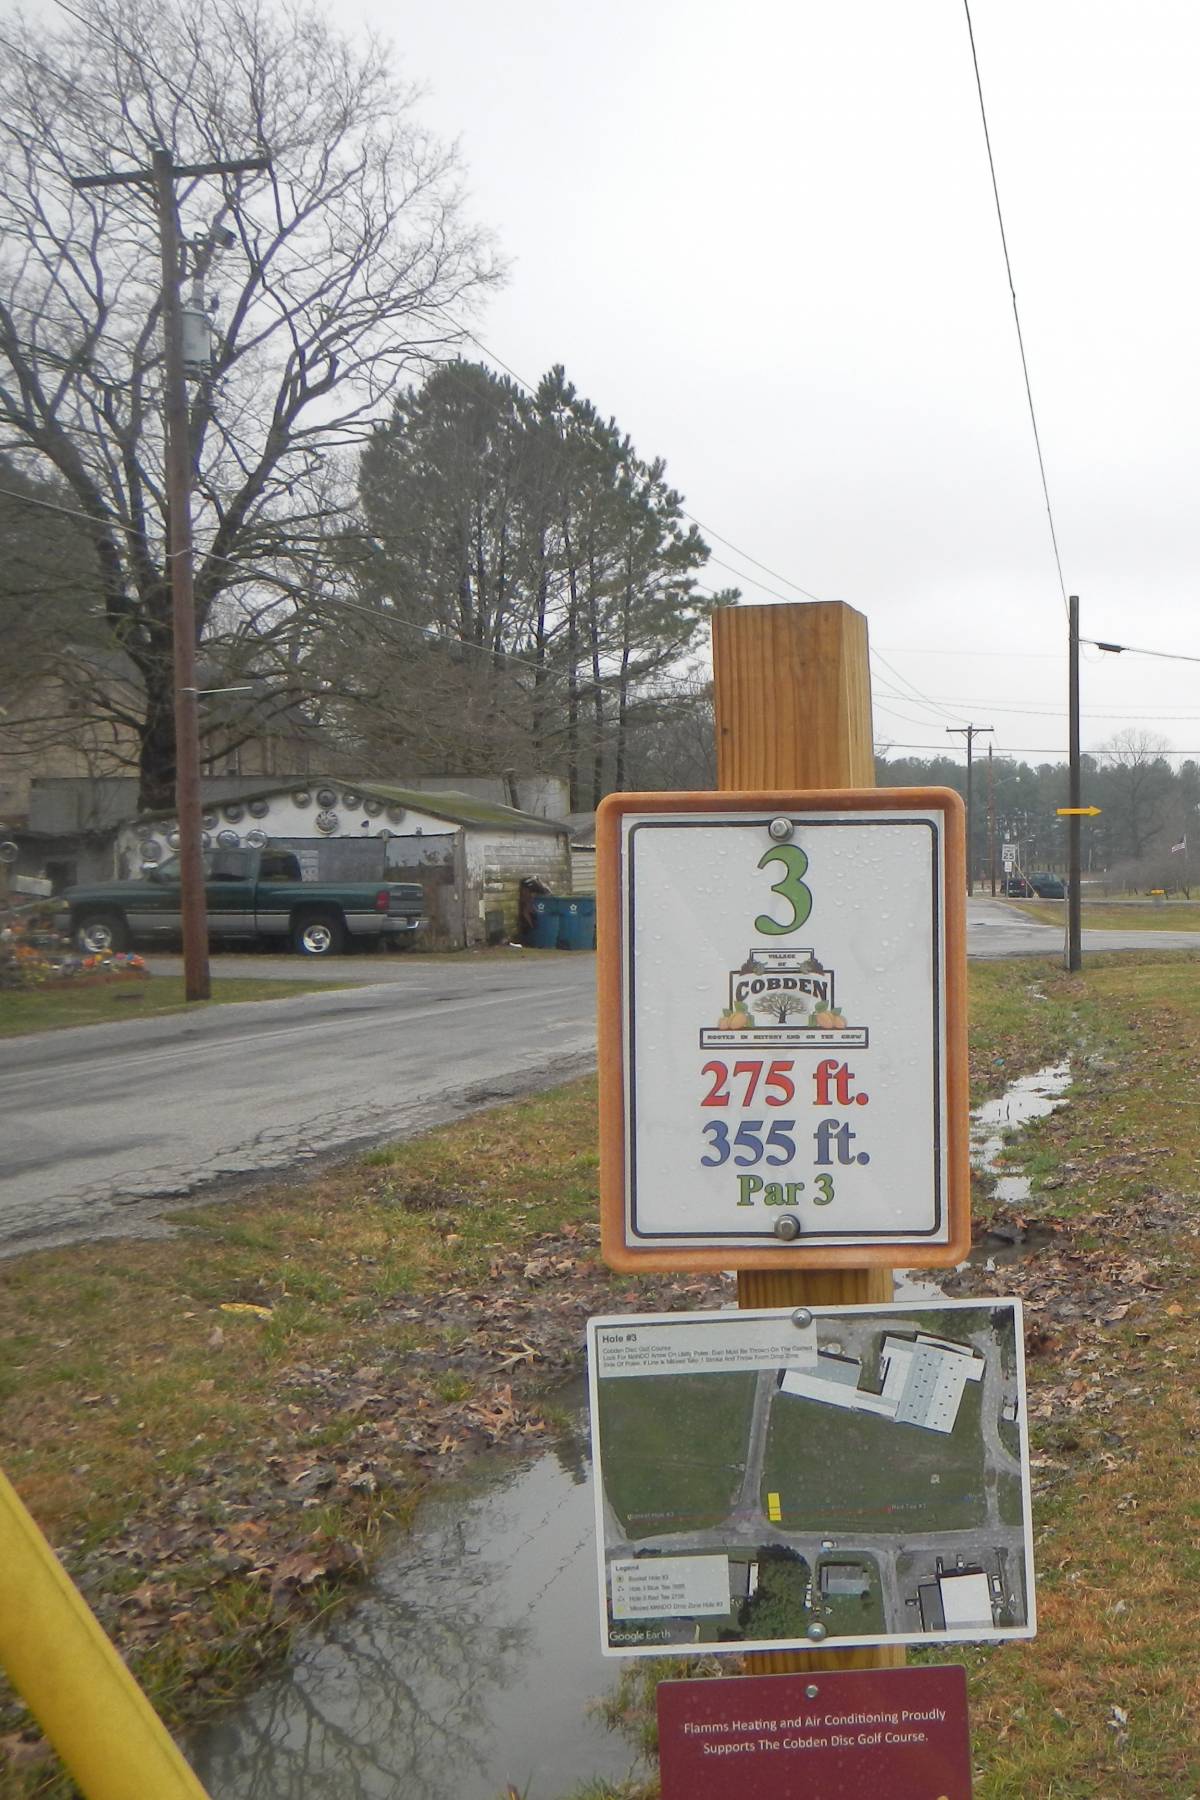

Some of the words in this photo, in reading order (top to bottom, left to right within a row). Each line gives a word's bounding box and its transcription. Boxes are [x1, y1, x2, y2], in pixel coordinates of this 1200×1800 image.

[755, 844, 813, 936] 3
[736, 978, 828, 1002] COBDEN
[701, 1061, 796, 1108] 275
[813, 1059, 870, 1106] ft.
[701, 1120, 796, 1168] 355
[813, 1119, 871, 1166] ft.
[737, 1174, 805, 1207] Par
[813, 1174, 835, 1206] 3
[602, 1334, 624, 1343] Hole
[626, 1333, 637, 1342] #3
[609, 1631, 645, 1642] Google
[646, 1629, 671, 1639] Earth
[684, 1722, 729, 1735] Flamms
[732, 1719, 777, 1733] Heating
[780, 1716, 802, 1729] and
[805, 1715, 822, 1727] Air
[825, 1712, 899, 1725] Conditioning
[902, 1708, 947, 1723] Proudly
[703, 1741, 756, 1756] Supports
[758, 1739, 780, 1751] The
[783, 1736, 828, 1750] Cobden
[831, 1734, 855, 1747] Disc
[858, 1732, 882, 1745] Golf
[885, 1731, 929, 1744] Course.
